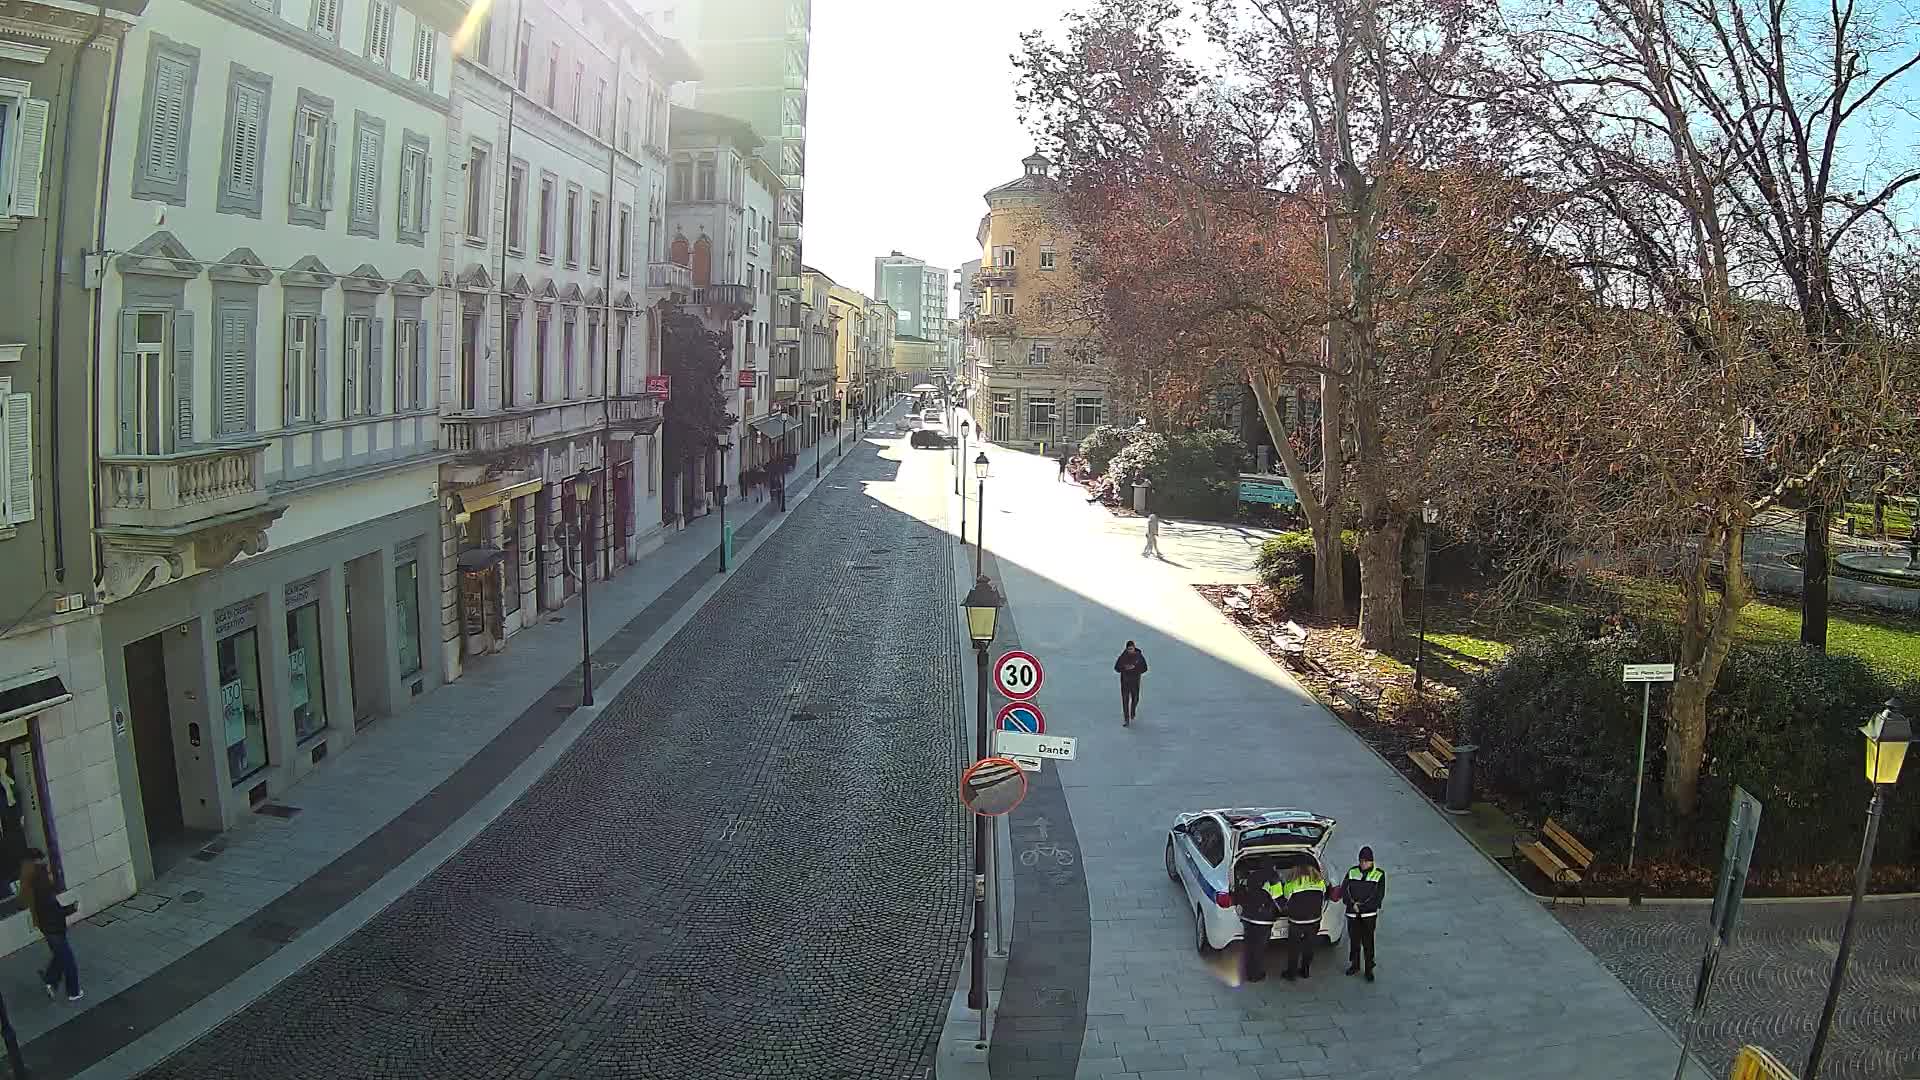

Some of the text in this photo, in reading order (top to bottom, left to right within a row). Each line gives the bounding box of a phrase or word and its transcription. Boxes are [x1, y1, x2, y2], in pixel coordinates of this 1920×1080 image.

[1005, 664, 1033, 686] 30
[222, 683, 241, 706] 130
[1039, 744, 1069, 755] Dante
